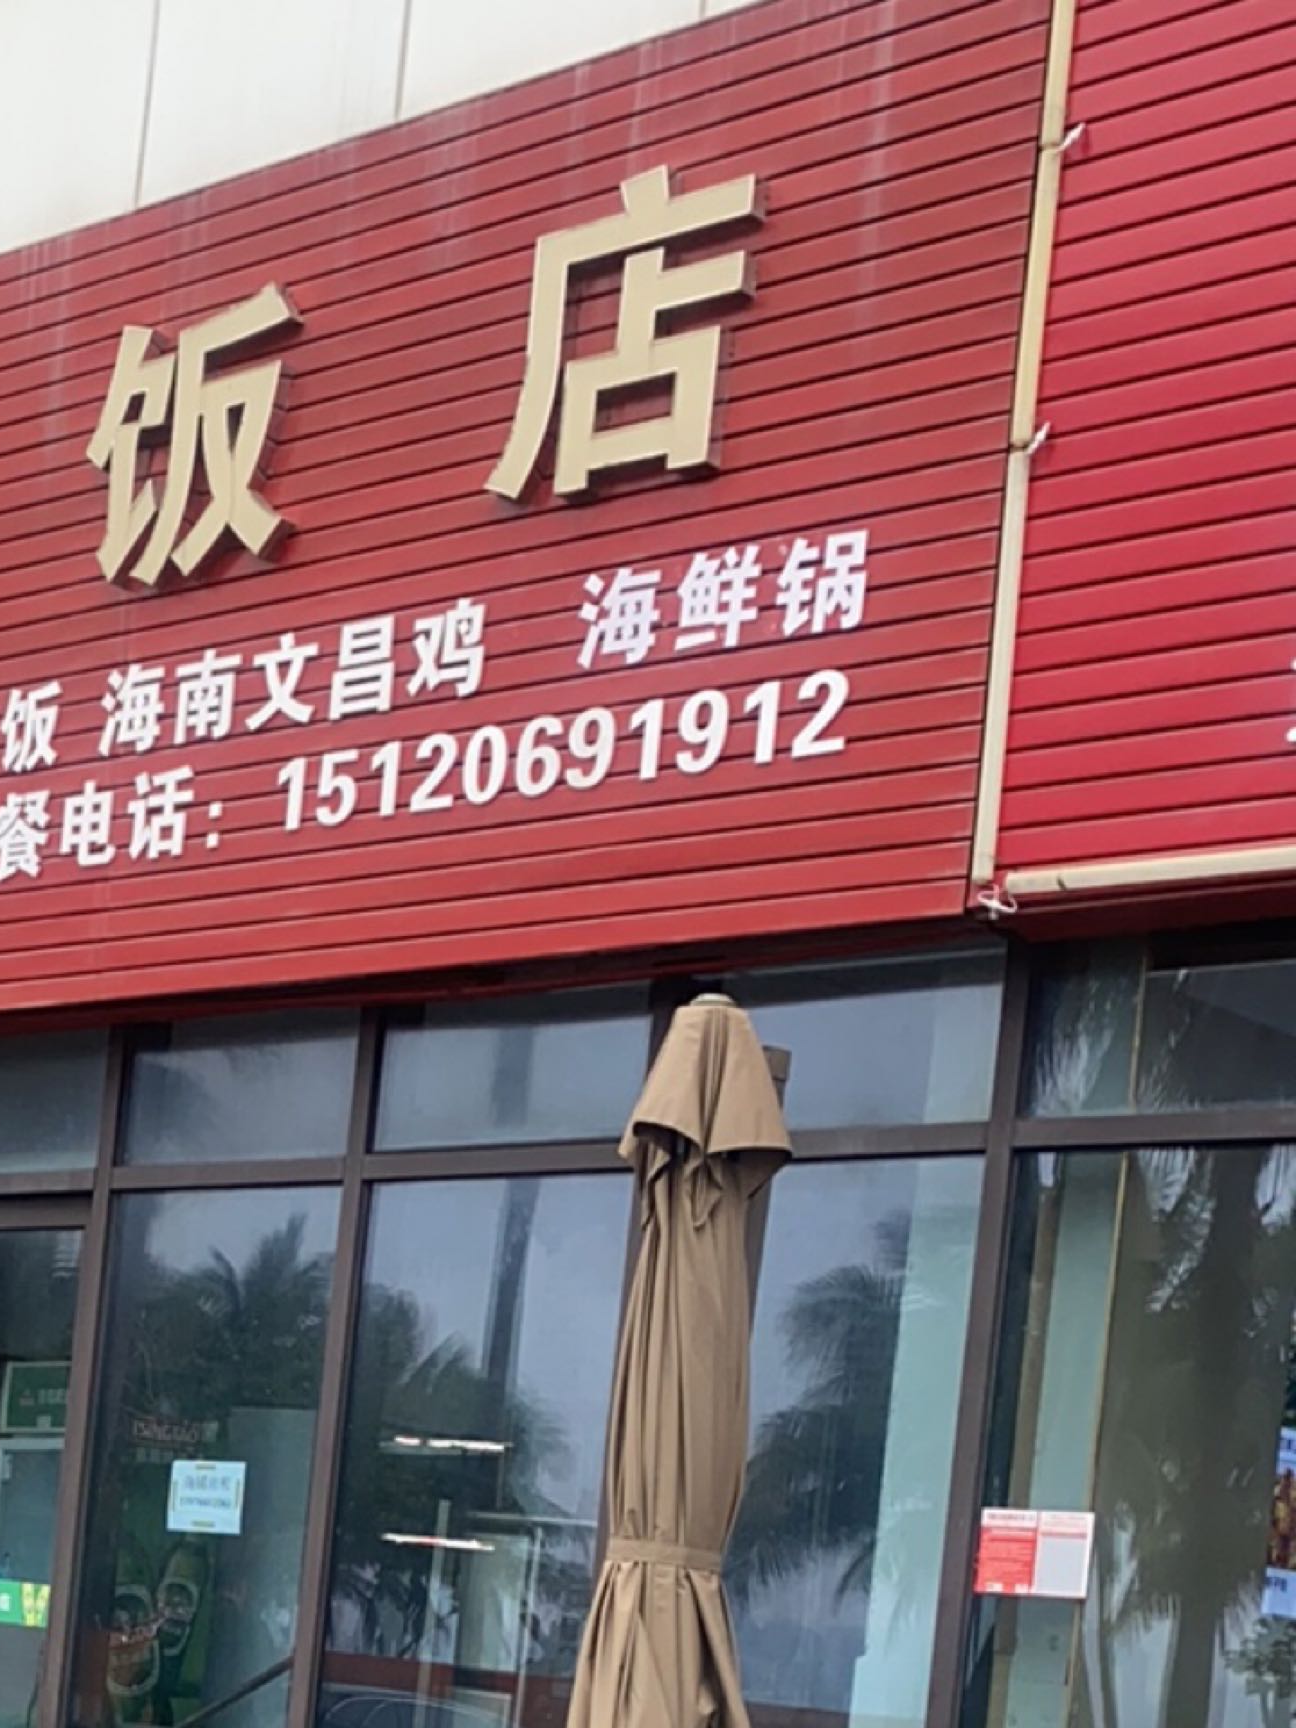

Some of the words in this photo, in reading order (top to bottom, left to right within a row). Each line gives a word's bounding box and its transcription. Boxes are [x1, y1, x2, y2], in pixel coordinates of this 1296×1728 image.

[96, 596, 487, 758] 海南文昌鸡
[575, 527, 870, 671] 海鲜锅
[275, 668, 850, 832] 15120691912
